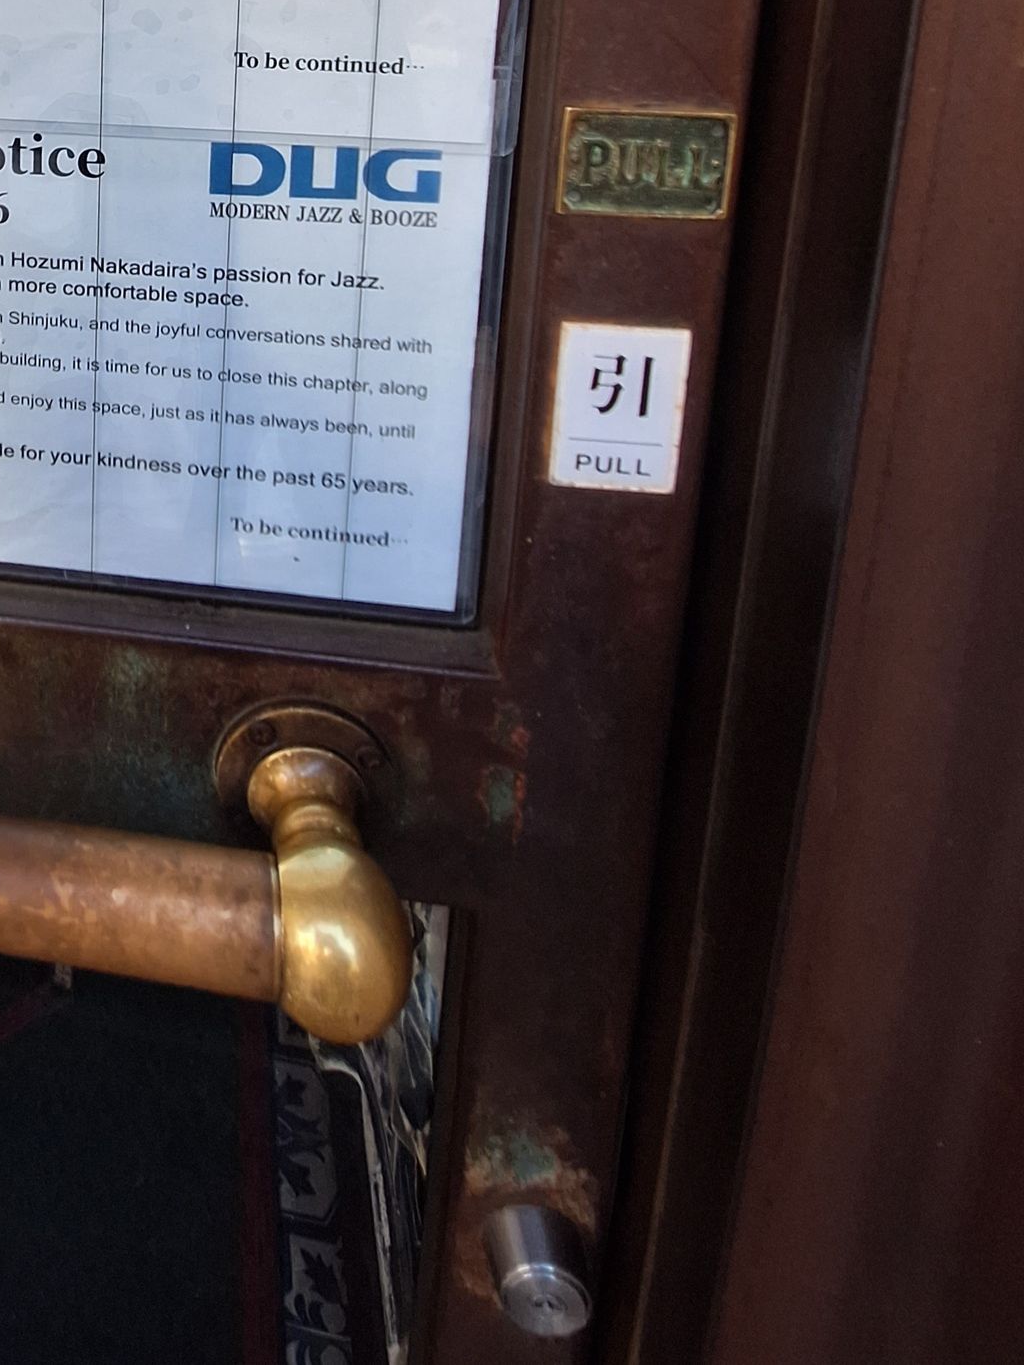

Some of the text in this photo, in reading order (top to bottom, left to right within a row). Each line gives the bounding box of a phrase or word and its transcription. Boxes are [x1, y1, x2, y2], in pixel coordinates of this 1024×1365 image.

[235, 51, 258, 69] To
[265, 53, 289, 70] be
[209, 142, 443, 203] DUG
[580, 137, 719, 190] PULL
[210, 201, 437, 227] MODERN JAZZ & BOOZE
[11, 252, 83, 271] Hozumi
[91, 257, 206, 280] Nakadaira's
[214, 266, 291, 285] passion
[298, 269, 325, 285] for
[331, 272, 384, 290] Jazz.
[9, 278, 56, 294] more
[63, 281, 177, 302] comfortable
[184, 289, 249, 307] space.
[9, 312, 83, 331] Shinjuku,
[89, 317, 120, 331] and
[155, 321, 200, 341] joyful
[206, 326, 325, 347] conversations
[330, 333, 391, 351] shared
[397, 338, 432, 354] with
[0, 350, 67, 371] building,
[105, 359, 140, 374] time
[218, 369, 262, 385] close
[268, 372, 297, 387] this
[303, 375, 373, 395] chapter,
[379, 381, 428, 401] along
[590, 354, 656, 417] 引
[11, 393, 54, 411] enjoy
[59, 397, 86, 411] this
[92, 399, 146, 418] space,
[149, 402, 181, 420] just
[226, 410, 254, 425] has
[260, 413, 320, 433] always
[325, 418, 373, 437] been,
[379, 424, 416, 440] until
[50, 449, 92, 468] your
[98, 451, 182, 475] kindness
[188, 462, 231, 479] over
[273, 470, 315, 489] past
[321, 473, 346, 490] 65
[352, 477, 413, 496] years.
[575, 454, 651, 477] PULL
[231, 517, 254, 533] To
